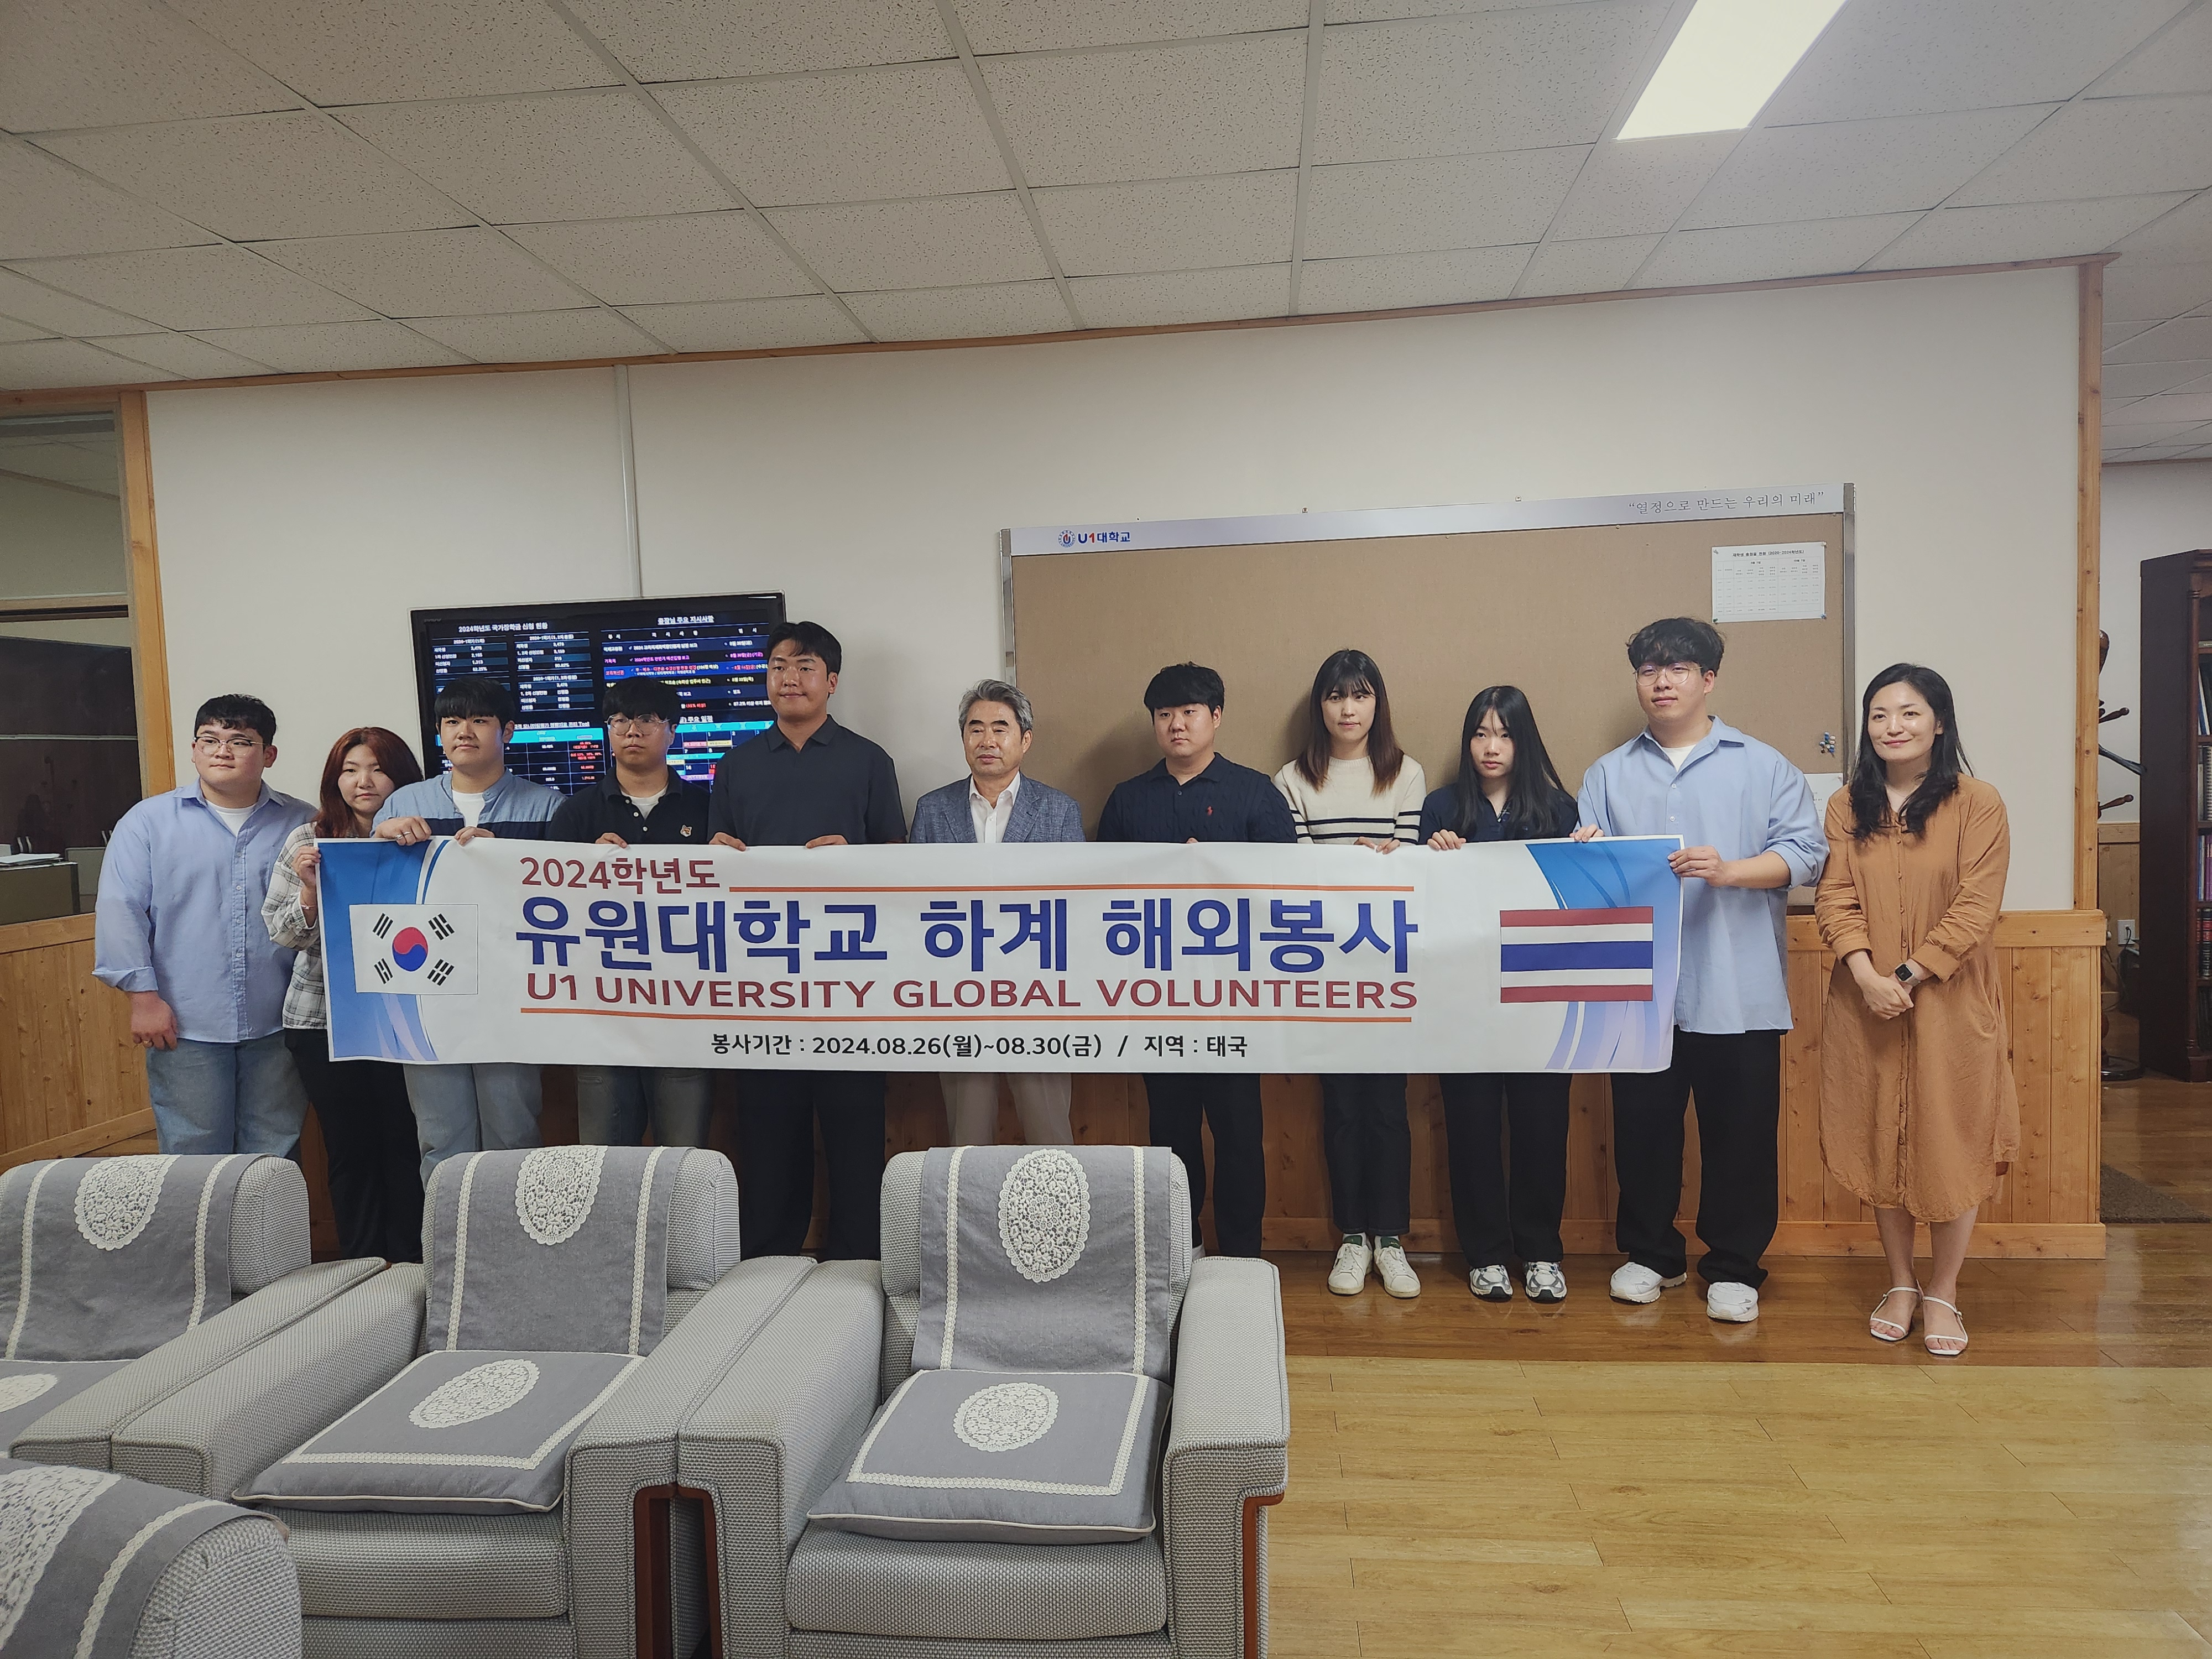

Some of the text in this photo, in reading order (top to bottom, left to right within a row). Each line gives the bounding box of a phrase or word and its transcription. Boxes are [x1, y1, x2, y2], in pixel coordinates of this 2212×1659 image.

[1697, 497, 1738, 511] 만드는
[1743, 493, 1783, 508] 우리의
[1078, 531, 1131, 544] U1대학교
[458, 624, 491, 633] 2024학년도
[492, 623, 521, 632] 국가장학금
[521, 857, 721, 894] 2024학년도
[515, 896, 1418, 974] 유원대학교 하계 해외봉사
[527, 972, 1418, 1010] U1 UNIVERSITY GLOBAL VOLUNTEERS
[711, 1032, 792, 1056] 봉사기간
[1144, 1035, 1186, 1057] 지역
[1206, 1035, 1249, 1058] 태국
